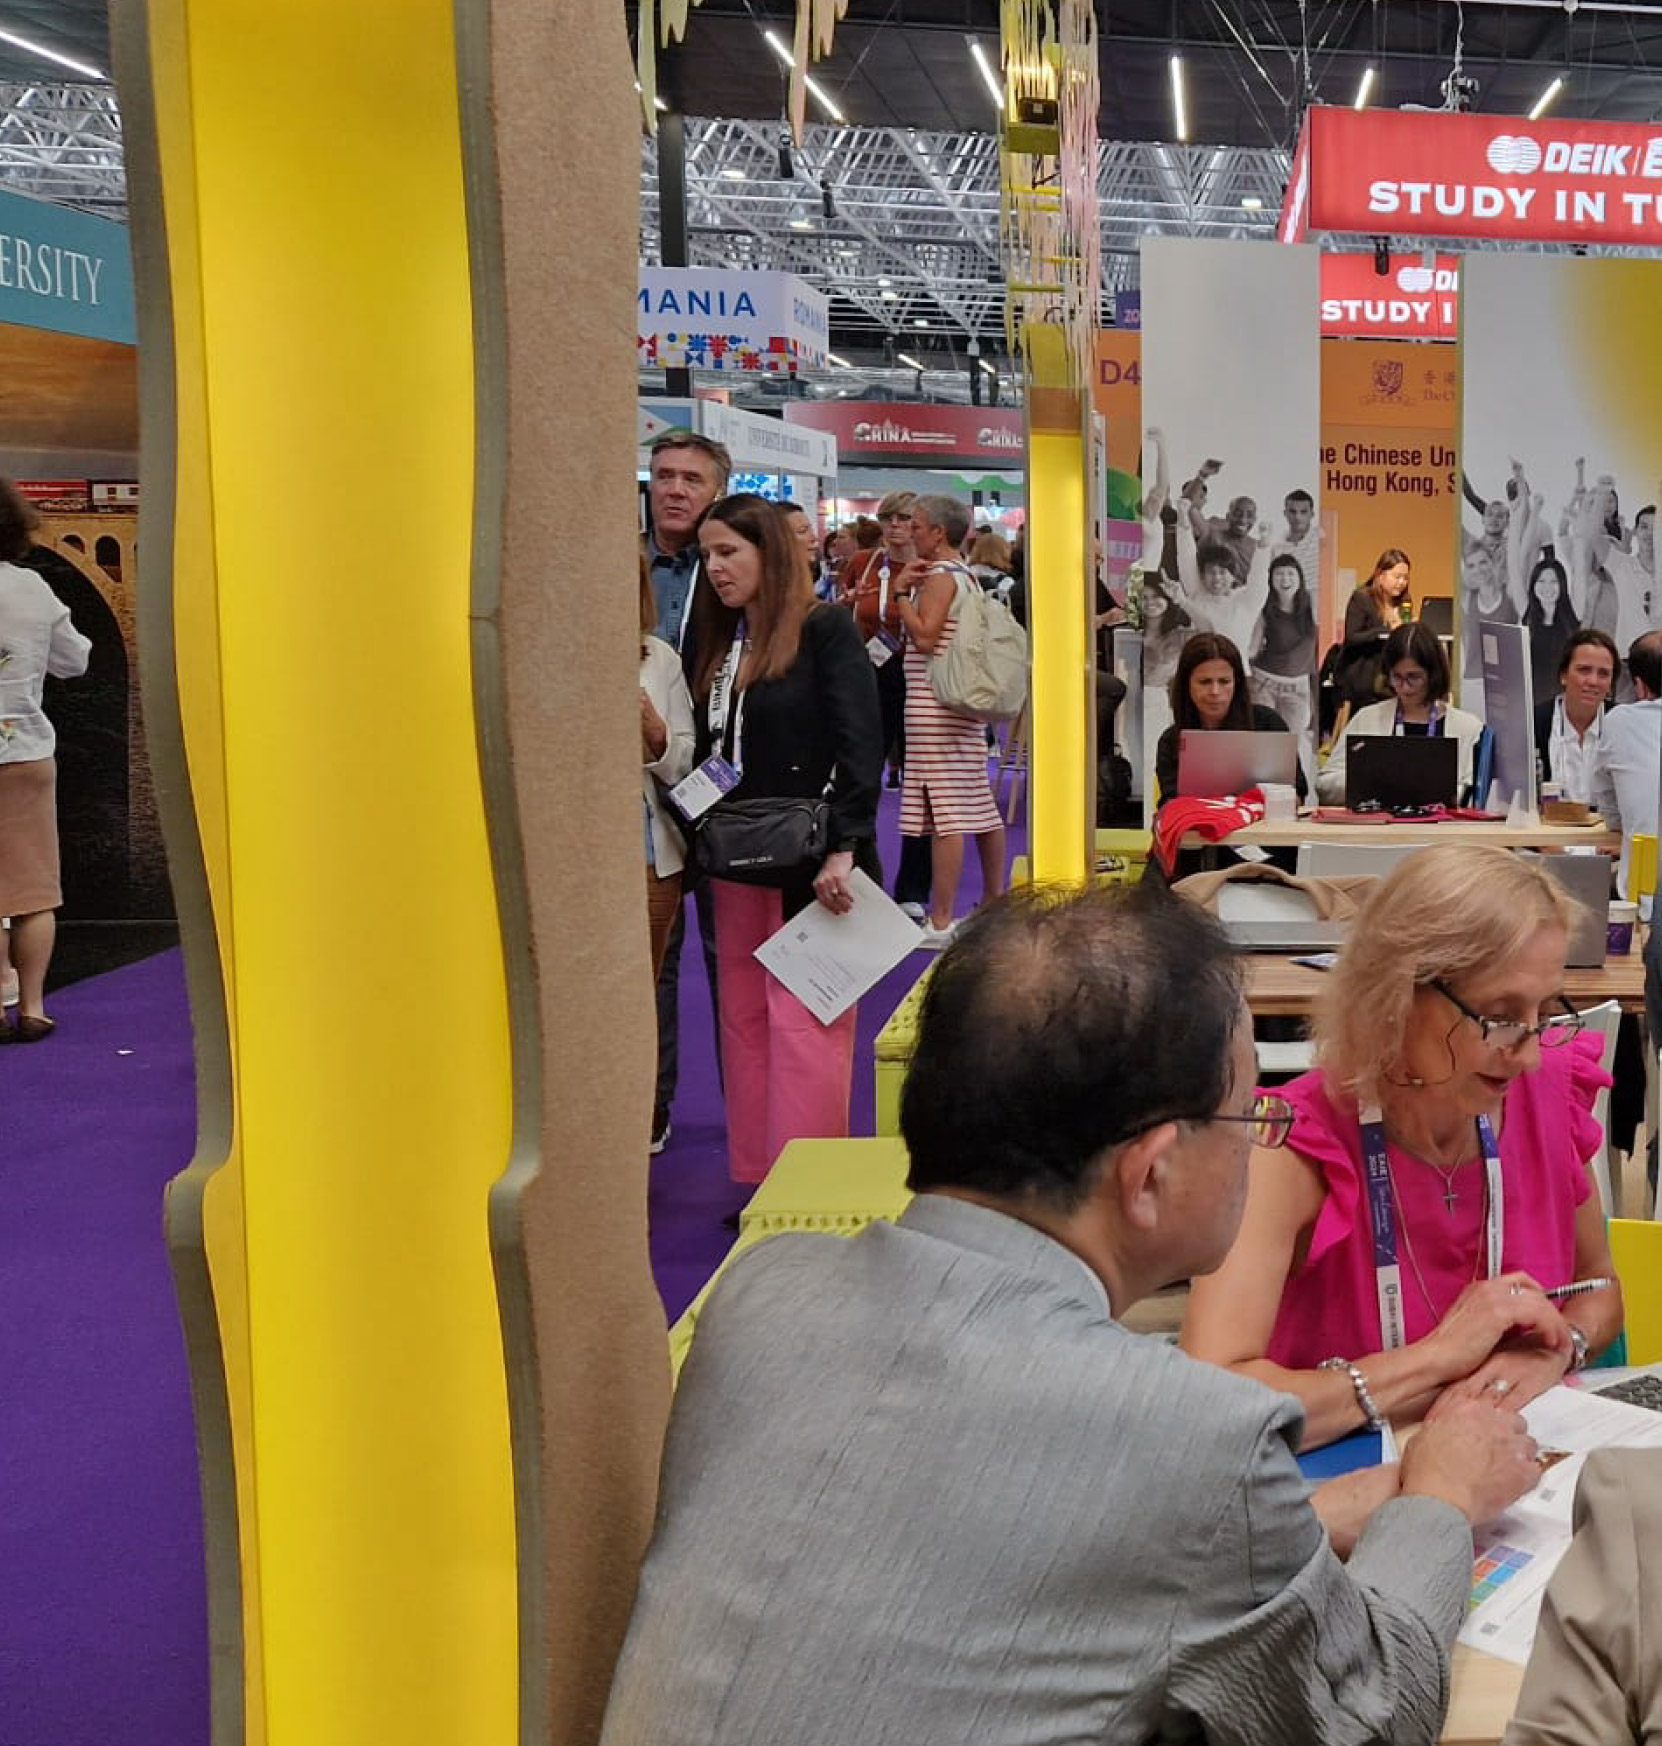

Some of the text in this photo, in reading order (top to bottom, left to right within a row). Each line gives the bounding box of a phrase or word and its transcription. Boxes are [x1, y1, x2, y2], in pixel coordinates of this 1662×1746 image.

[1368, 180, 1537, 219] STUDY
[1554, 189, 1606, 223] IN
[0, 233, 103, 305] ERSITY
[1321, 299, 1431, 323] STUDY
[1101, 359, 1142, 385] D4
[1344, 443, 1423, 466] Chinese
[1430, 445, 1456, 467] Un
[1326, 470, 1377, 497] Hong
[1385, 471, 1439, 498] Kong,
